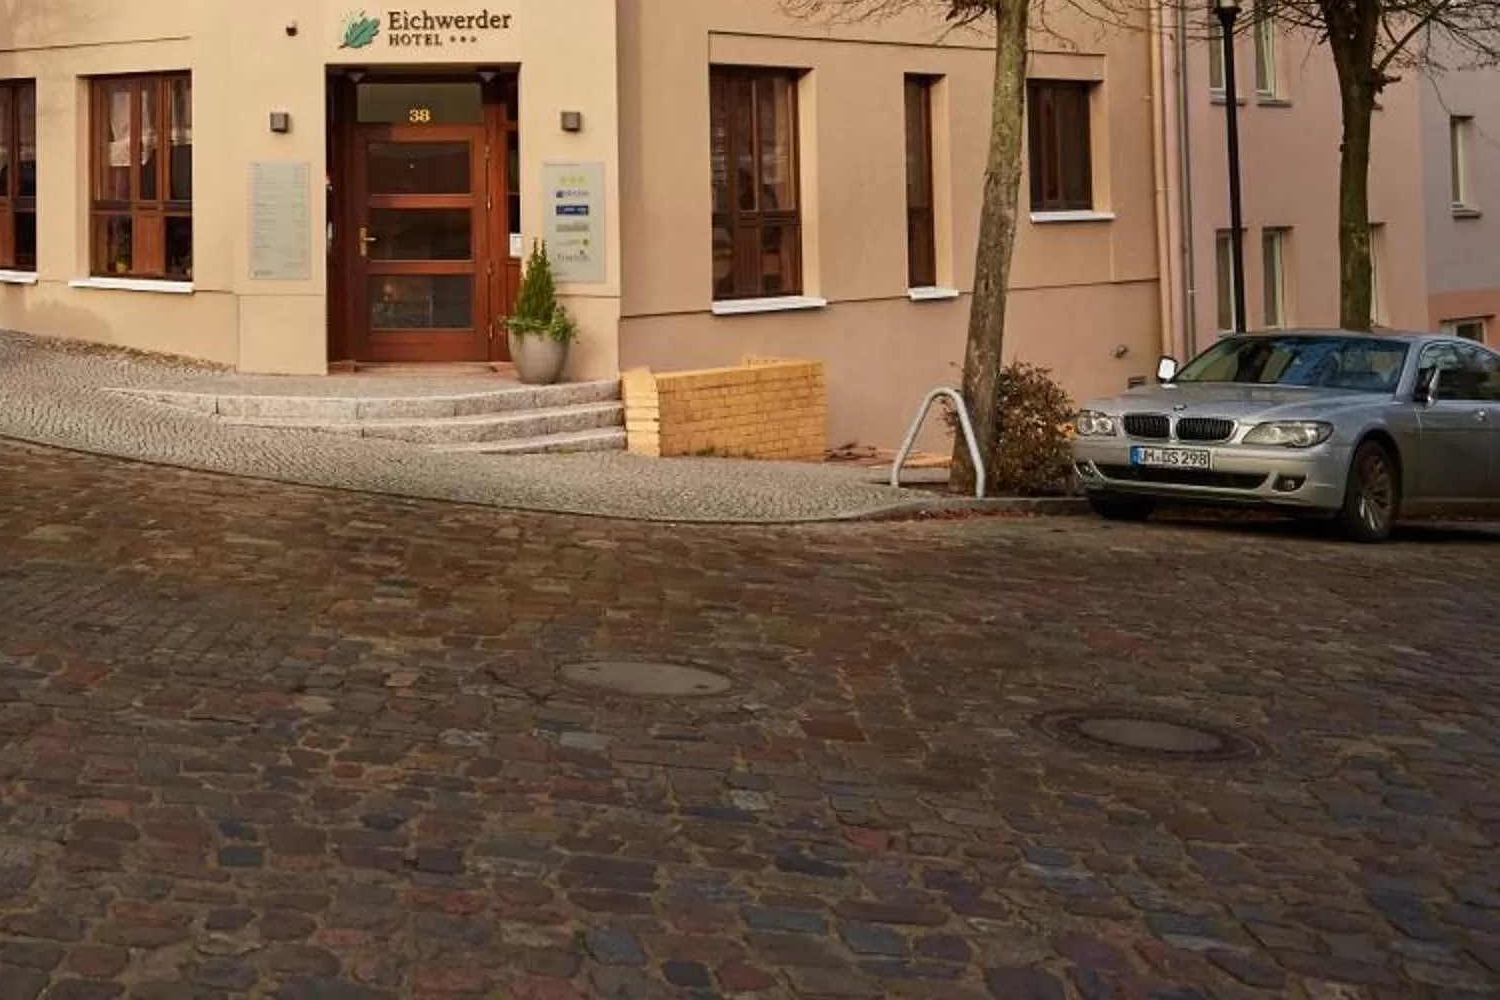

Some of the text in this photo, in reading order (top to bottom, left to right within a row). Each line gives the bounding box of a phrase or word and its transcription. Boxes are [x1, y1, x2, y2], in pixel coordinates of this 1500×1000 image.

[388, 9, 512, 31] Eichwerder
[389, 33, 443, 46] HOTEL
[409, 109, 430, 123] 38
[1181, 451, 1207, 466] 298
